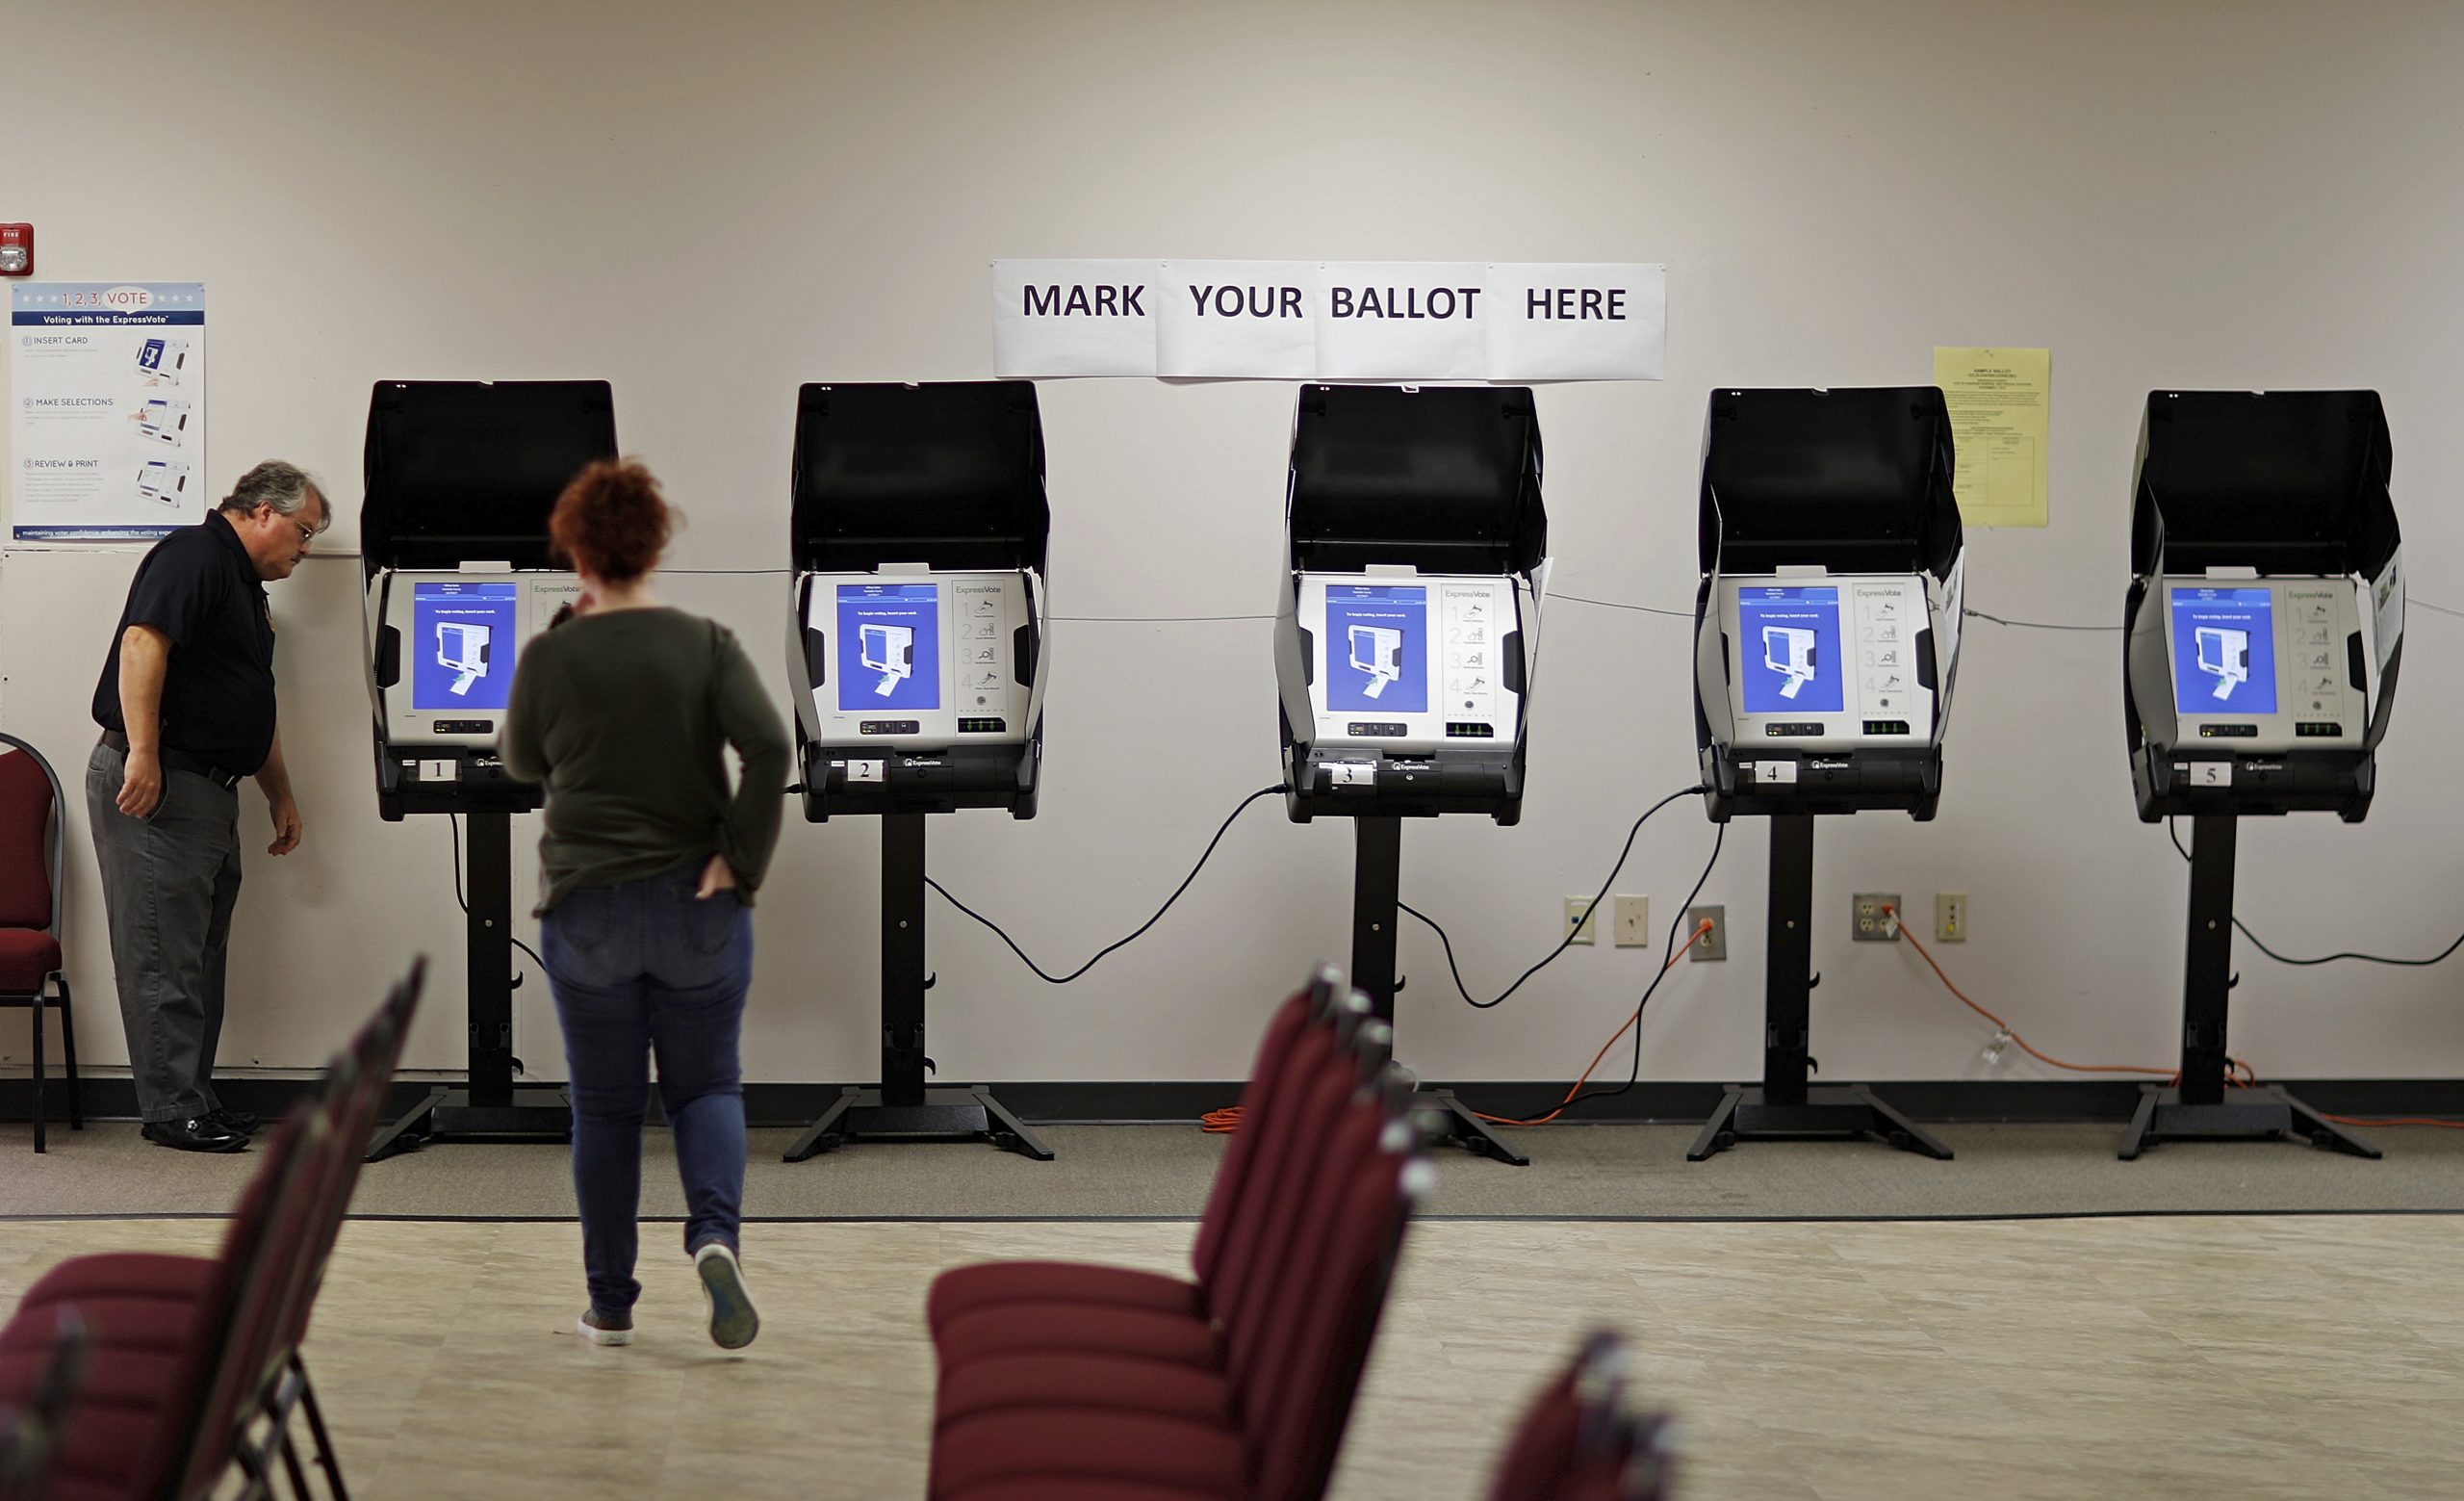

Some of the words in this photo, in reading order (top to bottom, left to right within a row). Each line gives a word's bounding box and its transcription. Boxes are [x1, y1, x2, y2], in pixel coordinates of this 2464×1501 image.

[63, 293, 71, 306] 1,
[76, 293, 87, 306] 2,
[90, 293, 102, 306] 3,
[107, 293, 147, 304] VOTE
[1023, 285, 1145, 317] MARK
[1189, 285, 1303, 319] YOUR
[1331, 287, 1481, 320] BALLOT
[1527, 289, 1627, 320] HERE
[43, 316, 72, 325] Voting
[956, 586, 1001, 595] ExpressVote
[1445, 590, 1490, 598] ExpressVote
[1857, 589, 1901, 597] ExpressVote
[435, 762, 442, 777] 1
[860, 762, 870, 777] 2
[1343, 767, 1353, 783] 3
[1767, 765, 1777, 780] 4
[2206, 768, 2216, 783] 5
